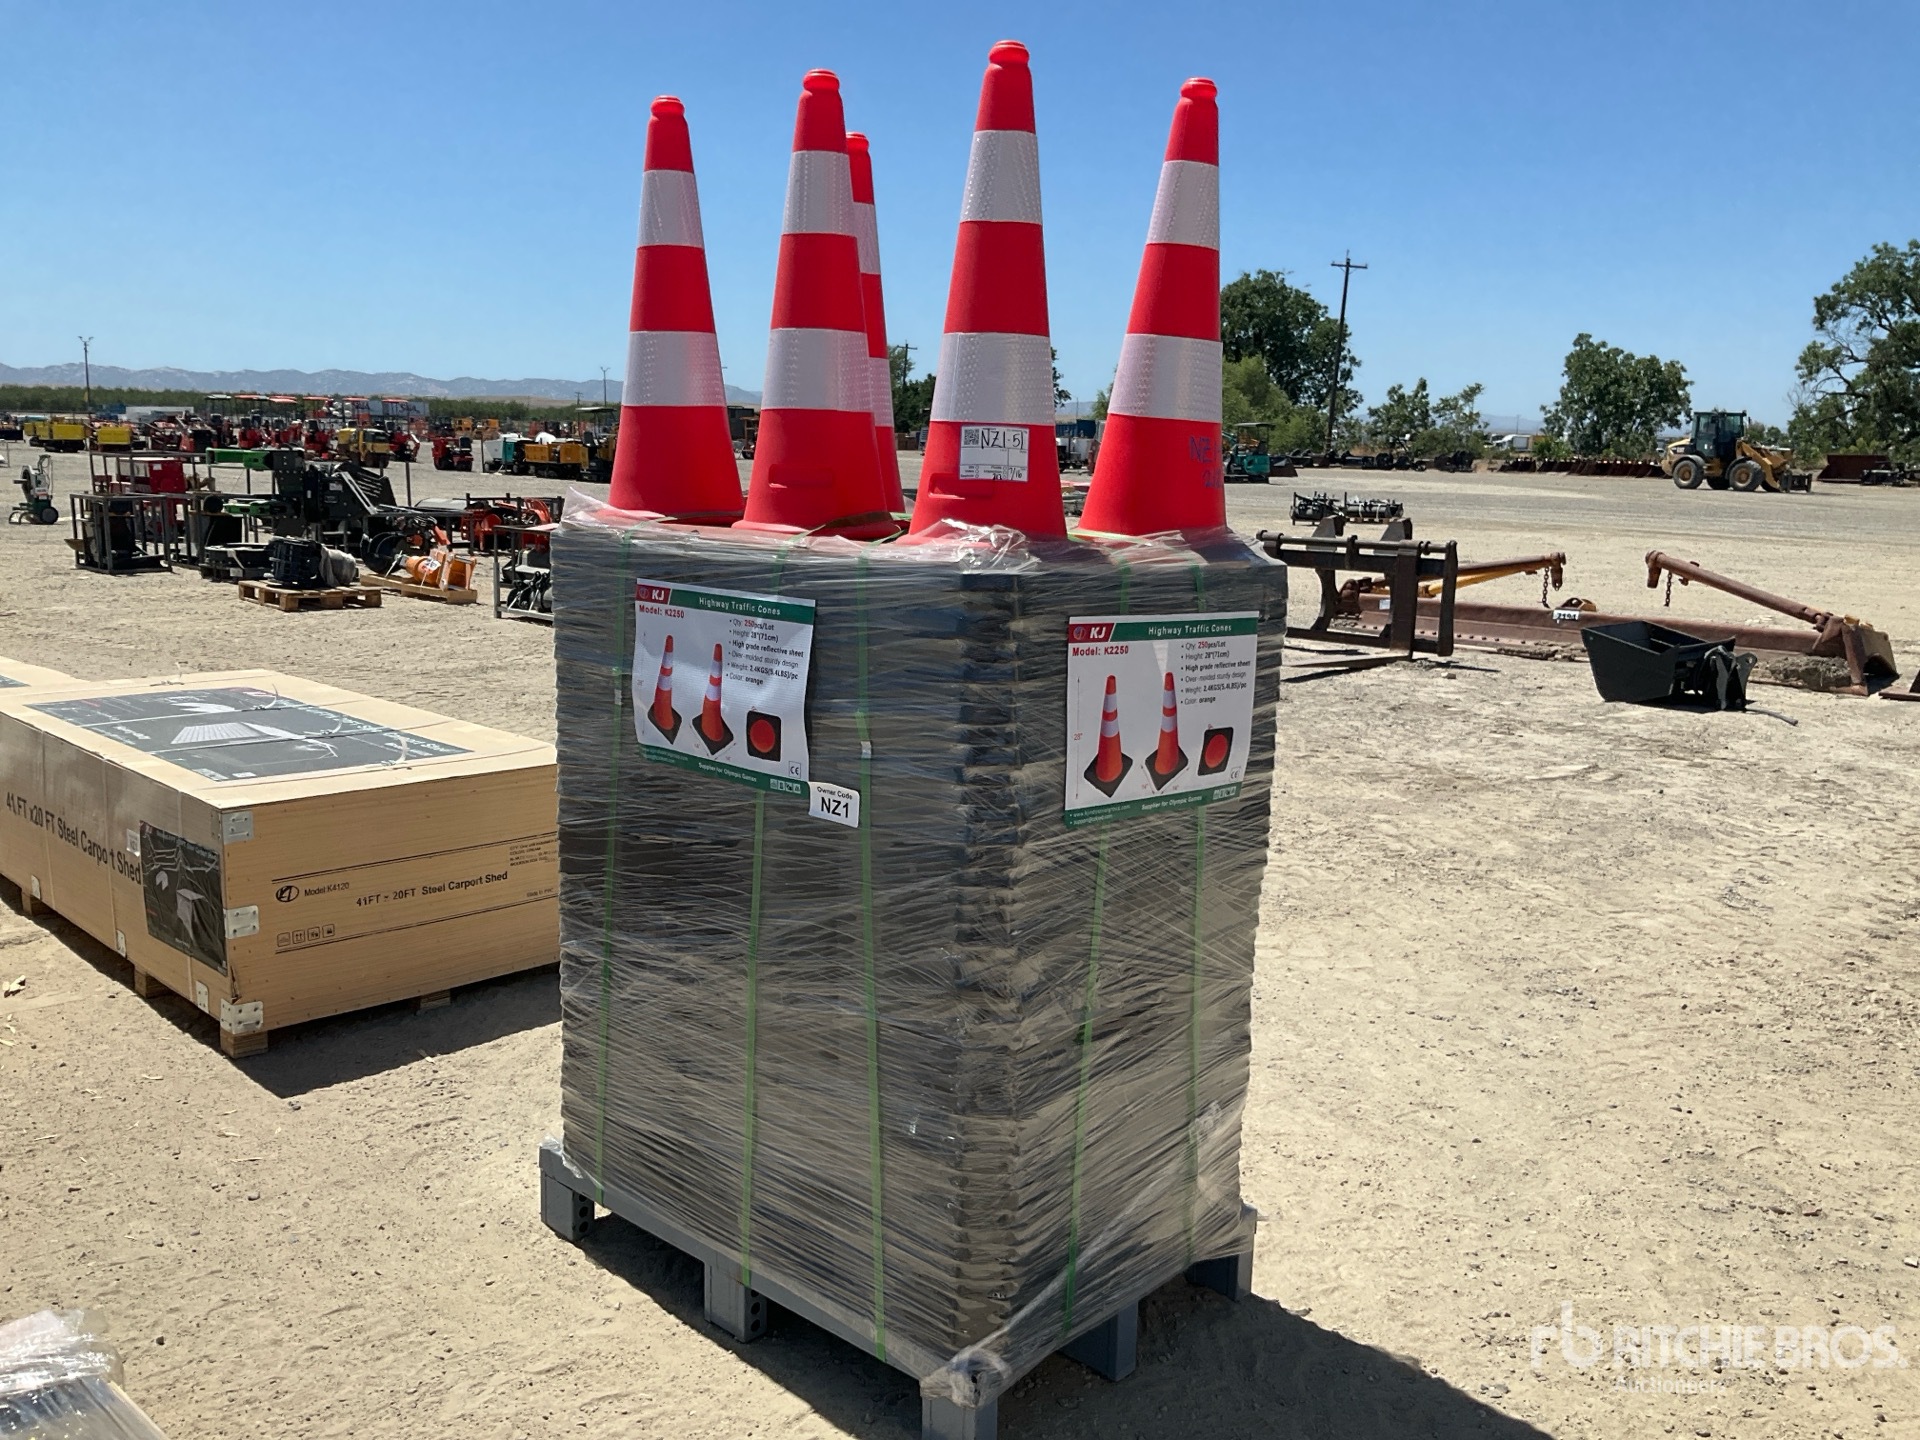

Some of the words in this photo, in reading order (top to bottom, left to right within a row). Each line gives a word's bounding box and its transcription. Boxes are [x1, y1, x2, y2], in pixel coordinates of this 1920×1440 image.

[651, 589, 665, 601] KJ
[639, 604, 663, 616] Model:
[664, 608, 685, 619] K2250
[699, 597, 730, 611] Highway
[731, 601, 755, 612] Traffic
[758, 605, 781, 616] Cones
[1089, 626, 1107, 639] KJ
[1148, 626, 1182, 636] Highway
[1185, 624, 1210, 634] Traffic
[1211, 623, 1232, 633] Cones
[732, 640, 745, 649] High
[746, 643, 760, 651] grade
[761, 645, 788, 655] reflective
[789, 649, 804, 658] sheet
[1072, 645, 1101, 657] Model:
[1104, 645, 1129, 655] K2250
[782, 659, 799, 669] design
[1185, 664, 1199, 672] High
[1200, 663, 1213, 672] grade
[745, 676, 764, 686] orange
[817, 786, 836, 797] Owner
[836, 789, 853, 800] Code
[820, 796, 850, 818] NZ1
[45, 810, 55, 834] FT
[57, 817, 79, 847] Steel
[80, 830, 116, 870] Carpot
[117, 851, 141, 885] Shed
[356, 893, 381, 907] 41FT
[392, 888, 416, 900] 20FT
[421, 883, 446, 896] Steel
[448, 876, 483, 890] Carport
[485, 871, 508, 884] Shed
